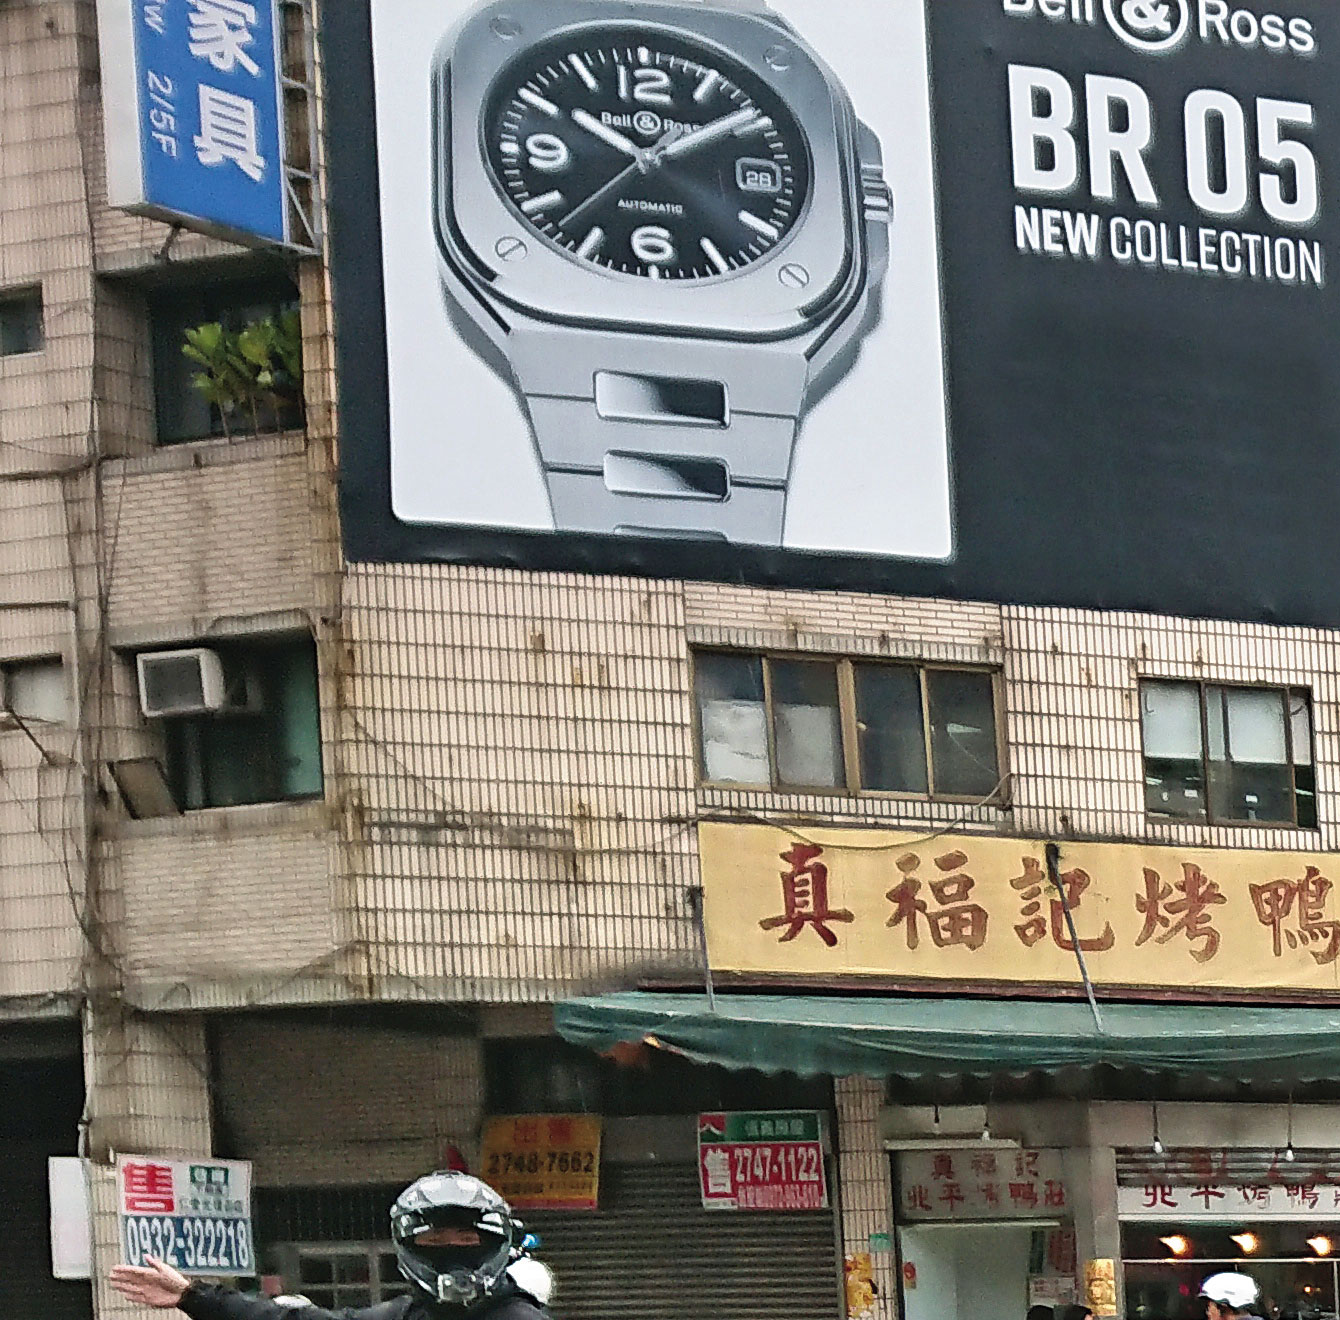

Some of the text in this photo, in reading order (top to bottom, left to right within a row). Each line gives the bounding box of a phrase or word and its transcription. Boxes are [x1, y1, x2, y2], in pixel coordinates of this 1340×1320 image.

[1199, 0, 1316, 53] Ross
[617, 65, 672, 102] 12
[148, 70, 177, 157] 2/5F
[525, 133, 568, 169] 9
[1007, 63, 1319, 223] BR 05
[631, 225, 673, 262] 6
[1014, 204, 1323, 285] NEW COLLECTION
